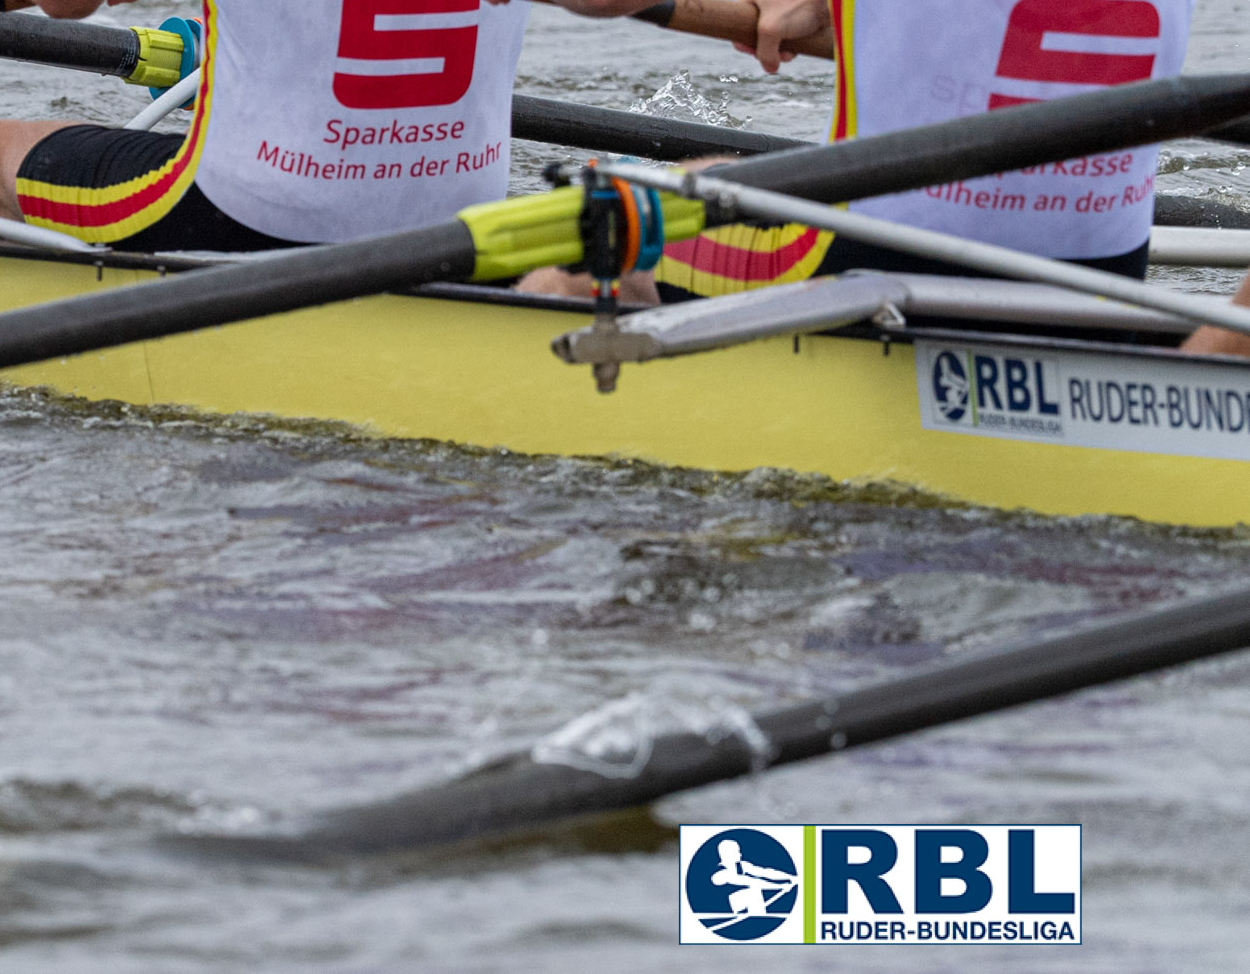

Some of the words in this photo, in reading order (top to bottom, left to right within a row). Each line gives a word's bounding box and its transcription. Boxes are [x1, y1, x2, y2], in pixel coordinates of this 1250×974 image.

[323, 119, 465, 150] Sparkasse
[257, 141, 366, 179] Mülheim
[373, 163, 402, 179] an
[409, 156, 449, 177] der
[455, 142, 502, 173] Ruhr
[1034, 193, 1066, 211] an
[1074, 191, 1117, 213] der
[975, 355, 1059, 415] RBL
